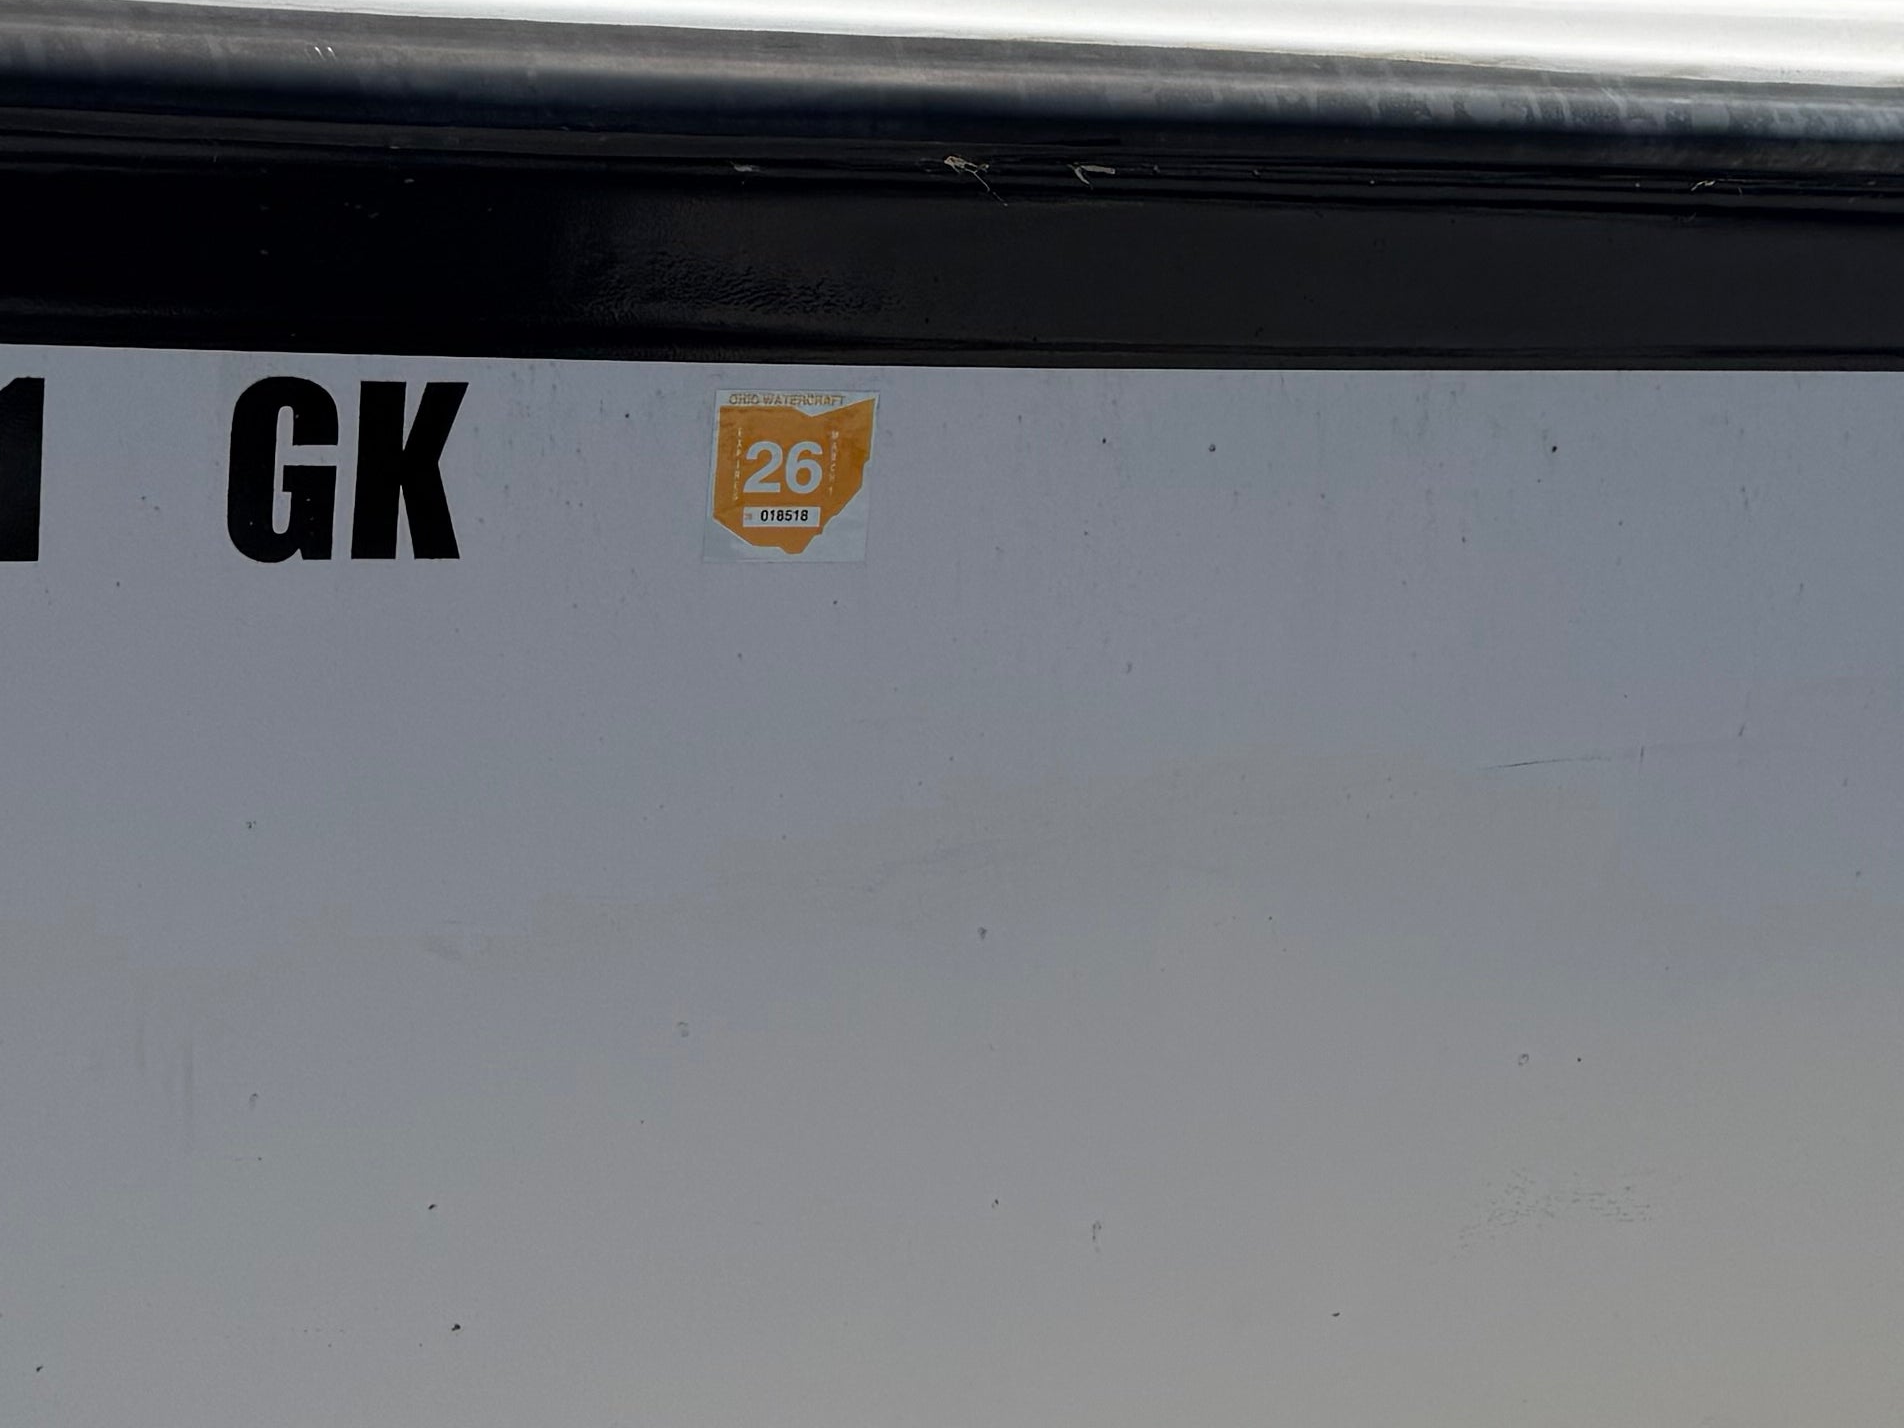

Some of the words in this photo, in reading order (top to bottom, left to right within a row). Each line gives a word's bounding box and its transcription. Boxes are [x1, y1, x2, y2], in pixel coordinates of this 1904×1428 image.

[729, 393, 759, 405] OHIO
[762, 393, 846, 406] WATERCRAFT
[226, 375, 470, 564] GK
[743, 440, 823, 494] 26
[760, 509, 809, 522] 018518
